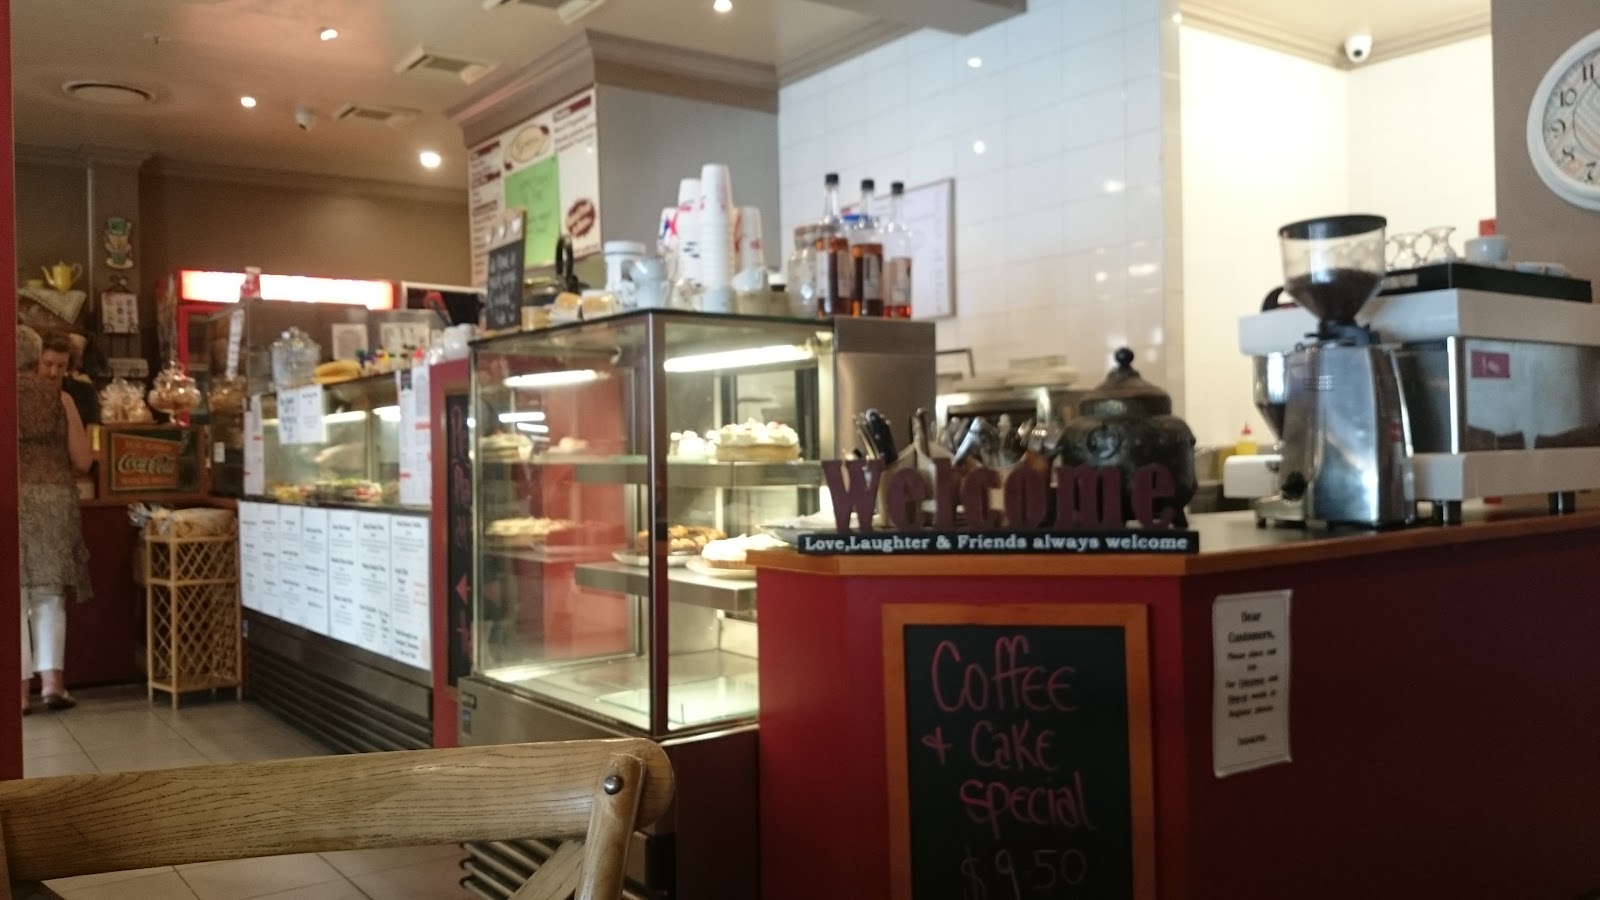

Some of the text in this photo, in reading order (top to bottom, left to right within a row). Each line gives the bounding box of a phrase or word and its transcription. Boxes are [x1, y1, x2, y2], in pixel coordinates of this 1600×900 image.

[1582, 63, 1595, 83] 11
[1560, 87, 1577, 107] 10
[1550, 118, 1566, 139] 9
[821, 457, 1177, 532] Welcome
[935, 534, 952, 550] &
[957, 533, 1028, 550] Friends
[1032, 534, 1100, 553] always
[1105, 534, 1189, 550] welcome
[1241, 611, 1262, 623] Dear
